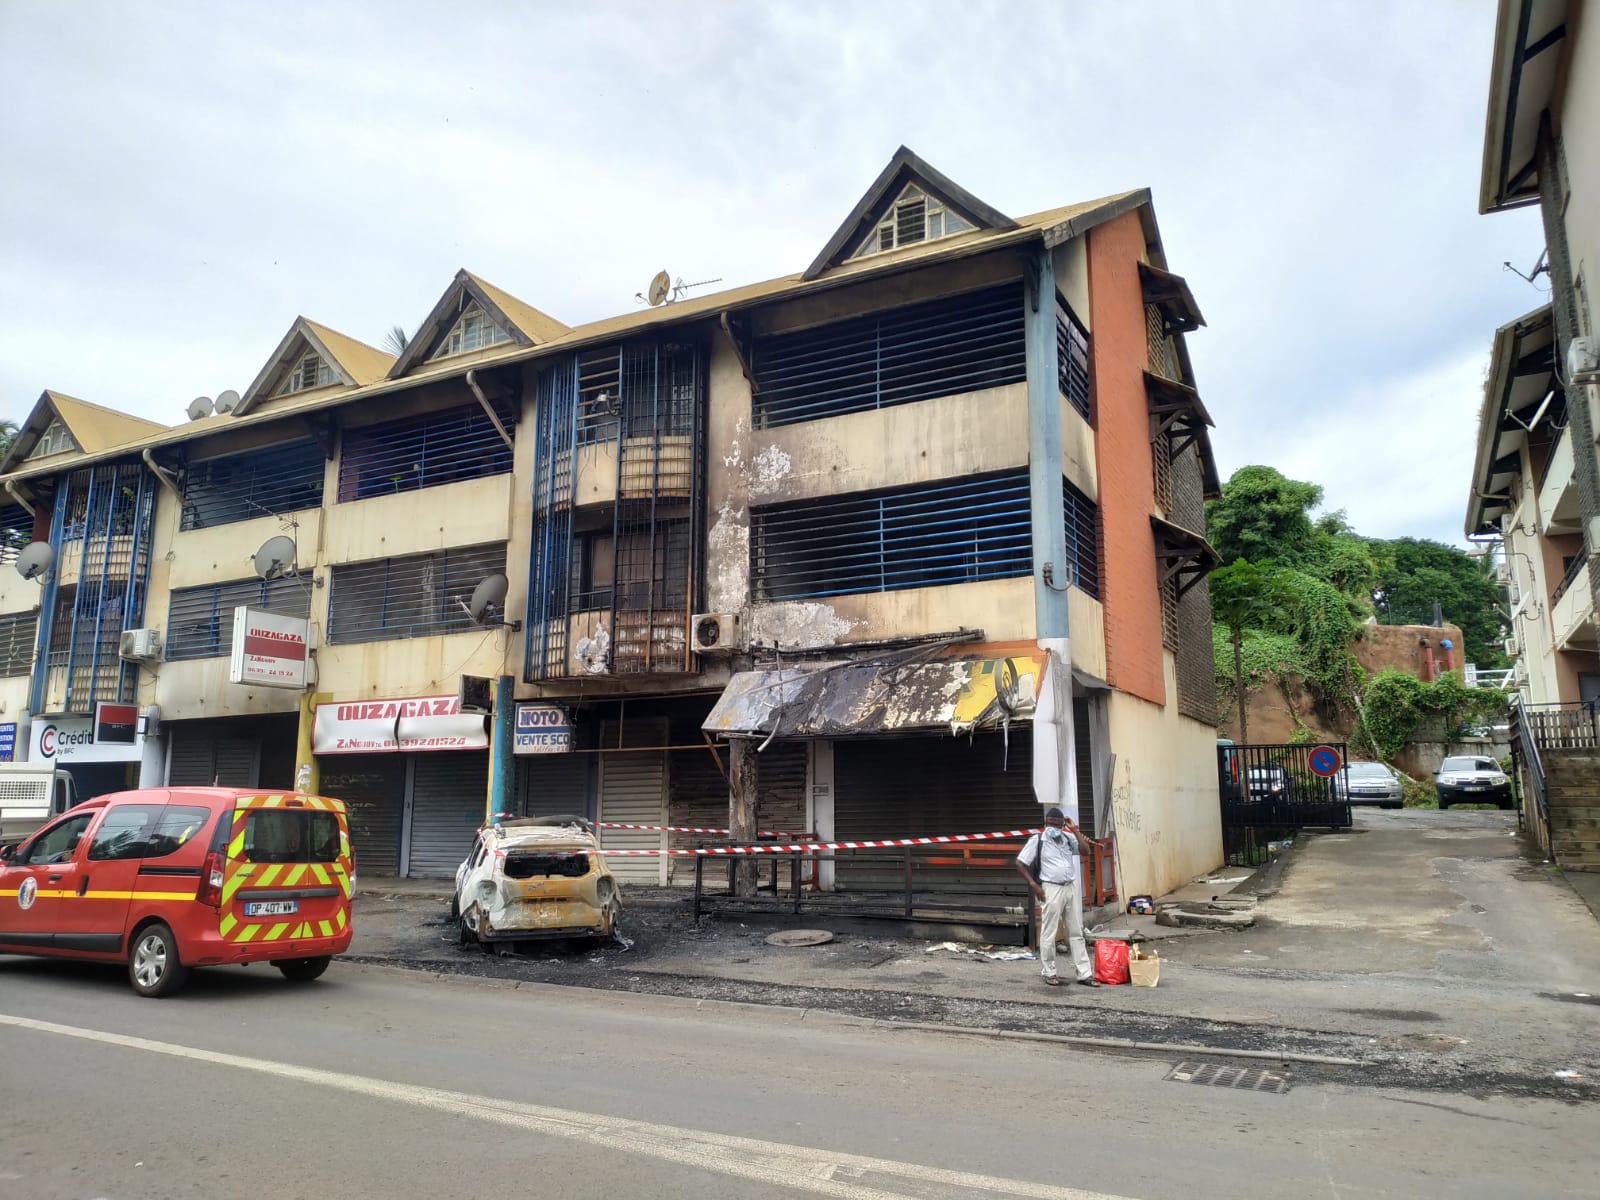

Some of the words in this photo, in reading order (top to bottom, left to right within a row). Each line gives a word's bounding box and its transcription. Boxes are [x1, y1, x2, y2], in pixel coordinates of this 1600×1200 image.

[250, 628, 303, 642] OUZAGAZA
[520, 711, 560, 725] MOTO
[516, 735, 548, 745] VENTE
